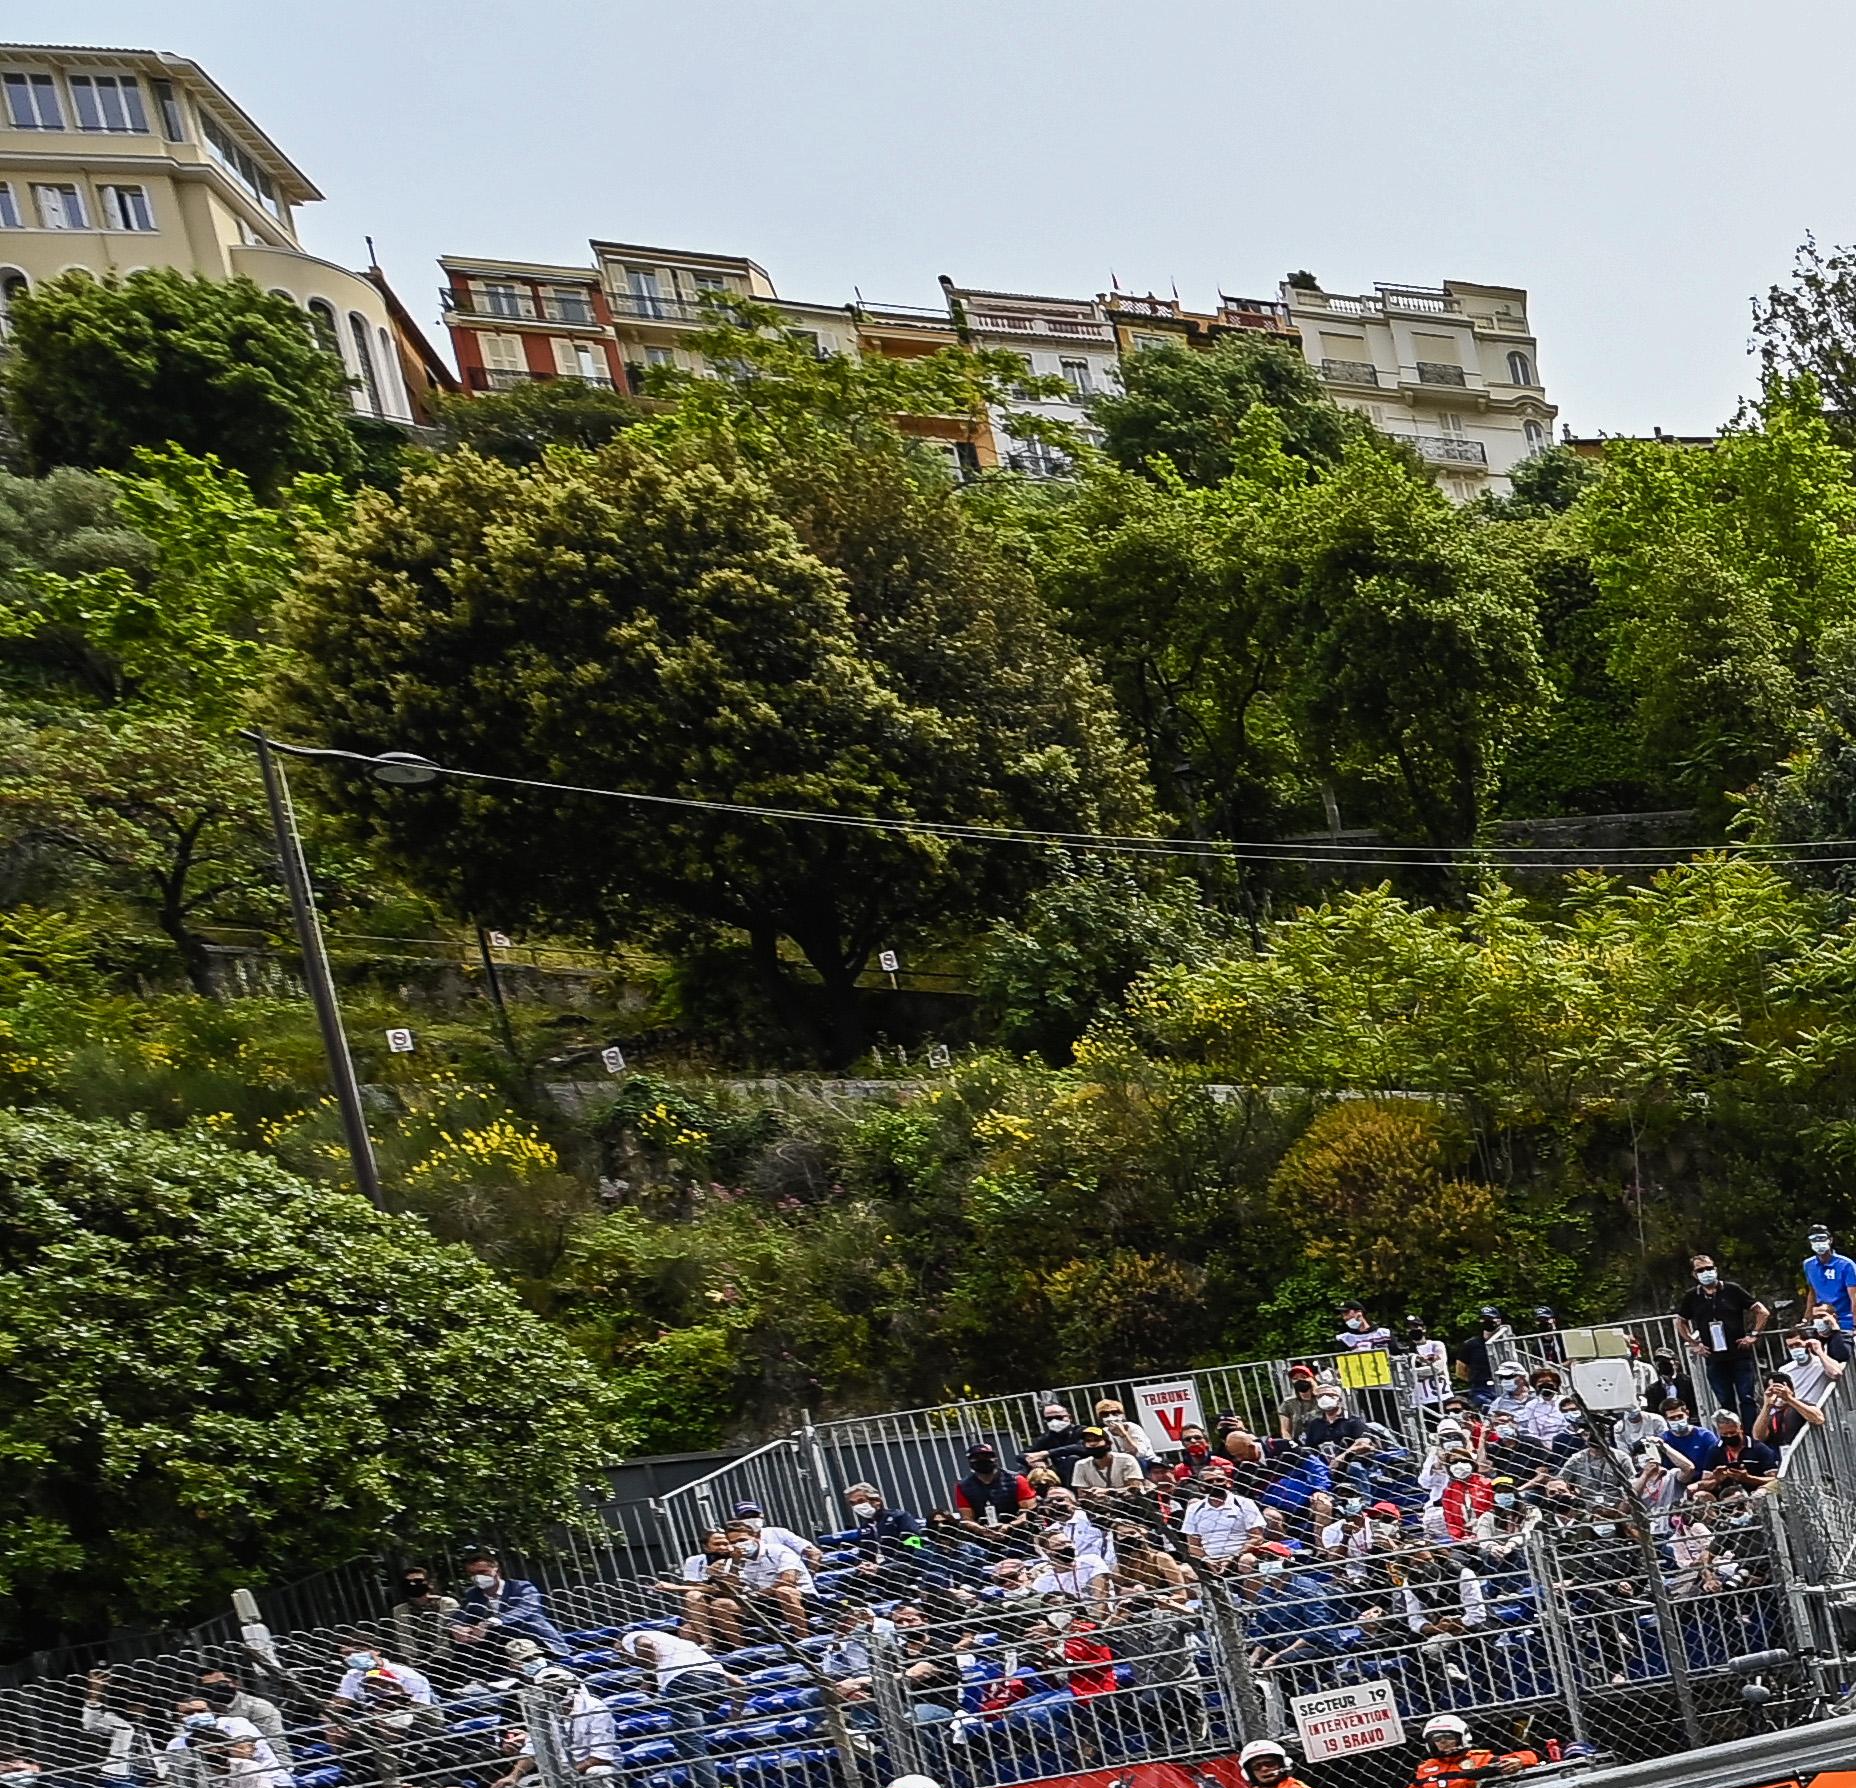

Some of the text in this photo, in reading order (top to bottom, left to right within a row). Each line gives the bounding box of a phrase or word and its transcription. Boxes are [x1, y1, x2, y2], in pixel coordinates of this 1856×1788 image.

[1141, 1388, 1192, 1407] TRIBUNE
[1154, 1406, 1184, 1442] V
[1299, 1688, 1387, 1717] SECTEUR 19
[1307, 1708, 1393, 1736] INTERVENTION
[1323, 1727, 1385, 1753] 19 BRAVO
